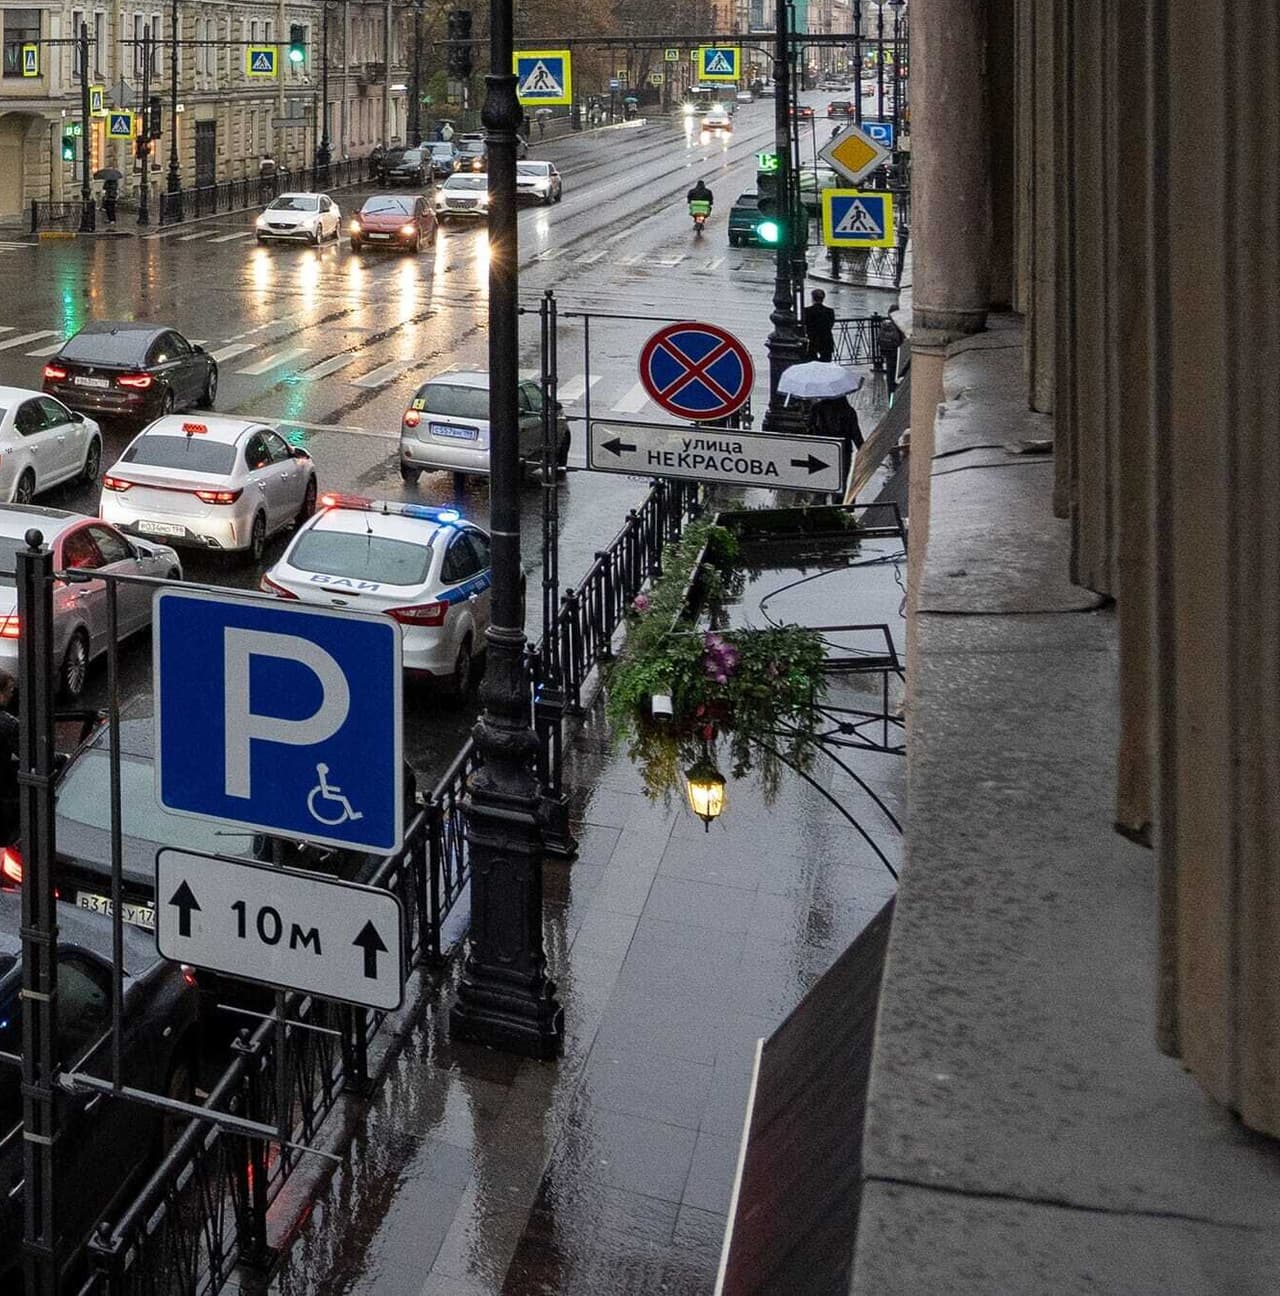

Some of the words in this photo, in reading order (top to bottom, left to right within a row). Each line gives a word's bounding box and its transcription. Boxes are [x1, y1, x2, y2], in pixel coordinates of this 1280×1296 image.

[682, 437, 743, 454] улица
[647, 450, 779, 477] НЕКРАСОВА
[309, 574, 380, 593] ВАИ
[224, 626, 351, 800] P
